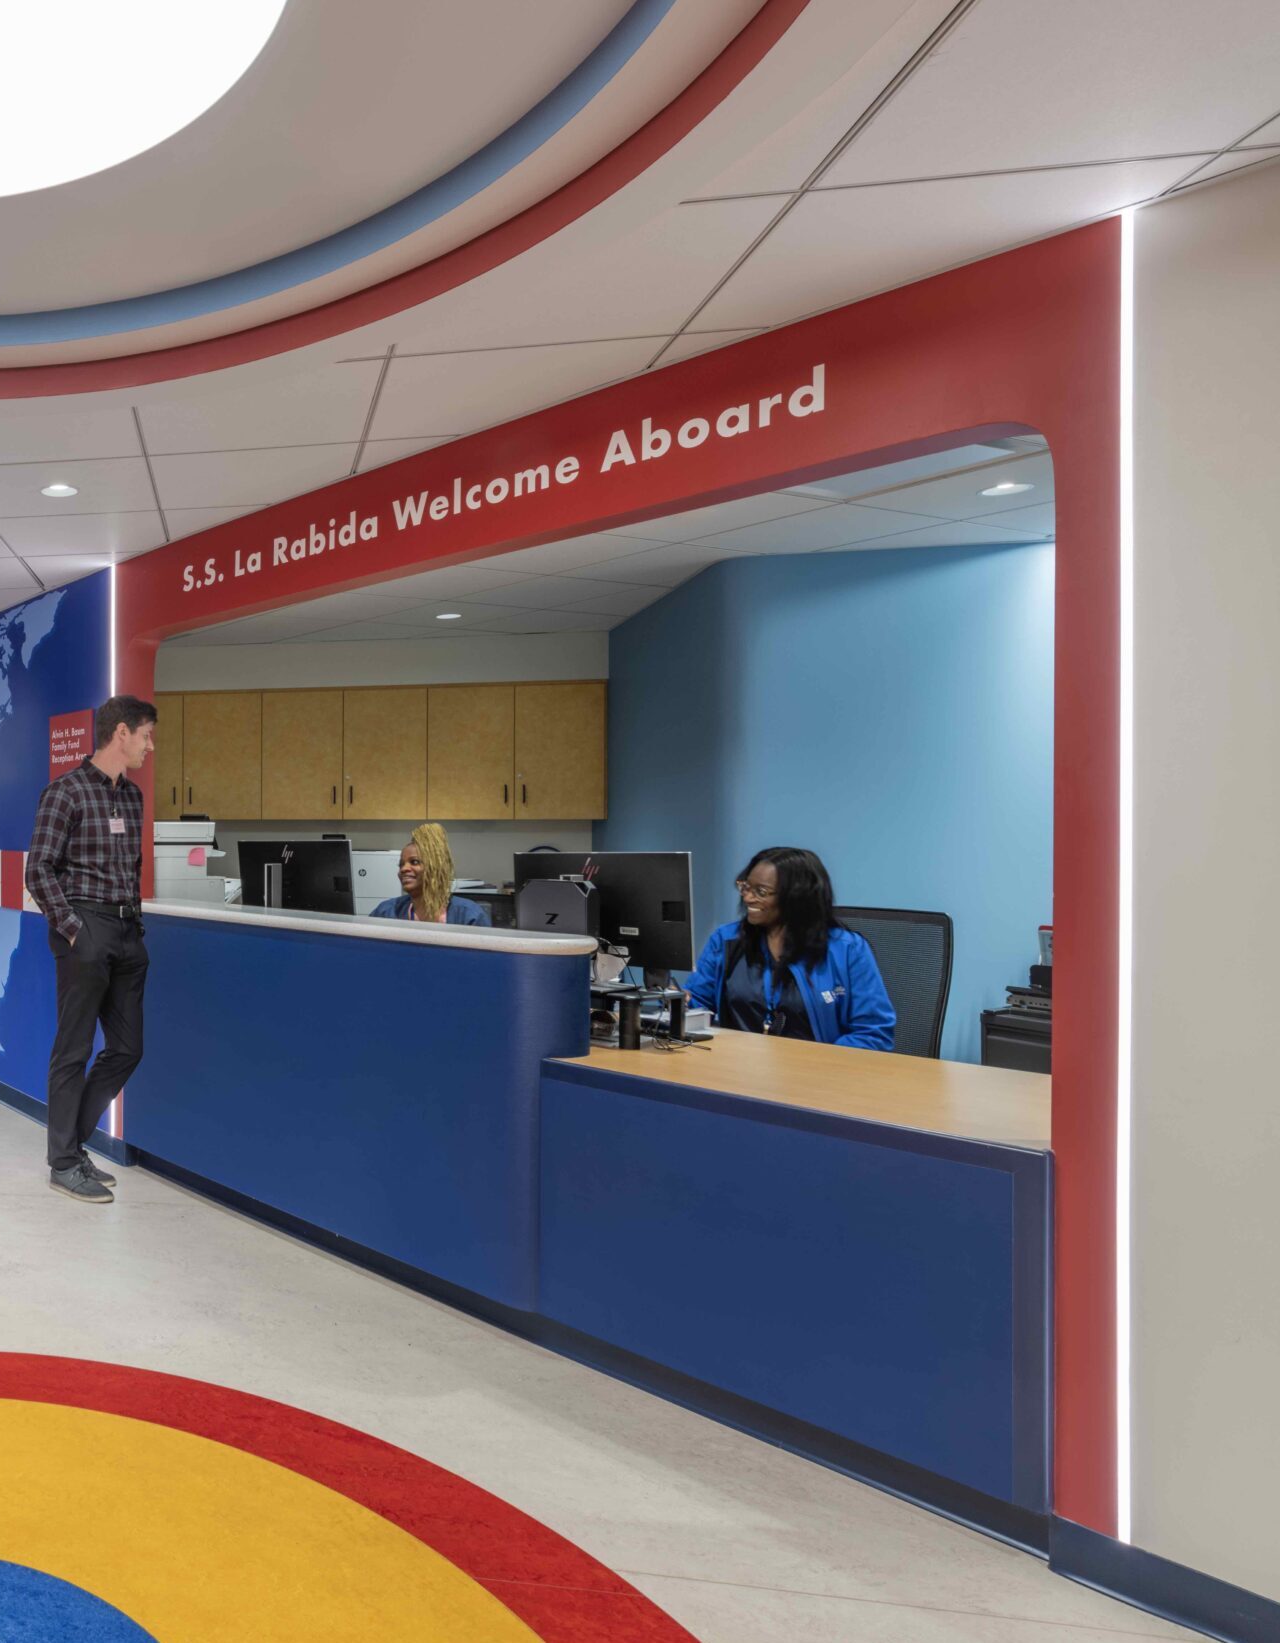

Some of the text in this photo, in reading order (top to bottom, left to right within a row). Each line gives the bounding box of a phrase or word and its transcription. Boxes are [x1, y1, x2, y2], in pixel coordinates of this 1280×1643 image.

[183, 363, 825, 592] S.S. La Rabida Welcome Aboard
[52, 738, 80, 752] Family Fund
[52, 752, 74, 764] Reception
[281, 844, 294, 864] hp
[545, 912, 559, 925] Z
